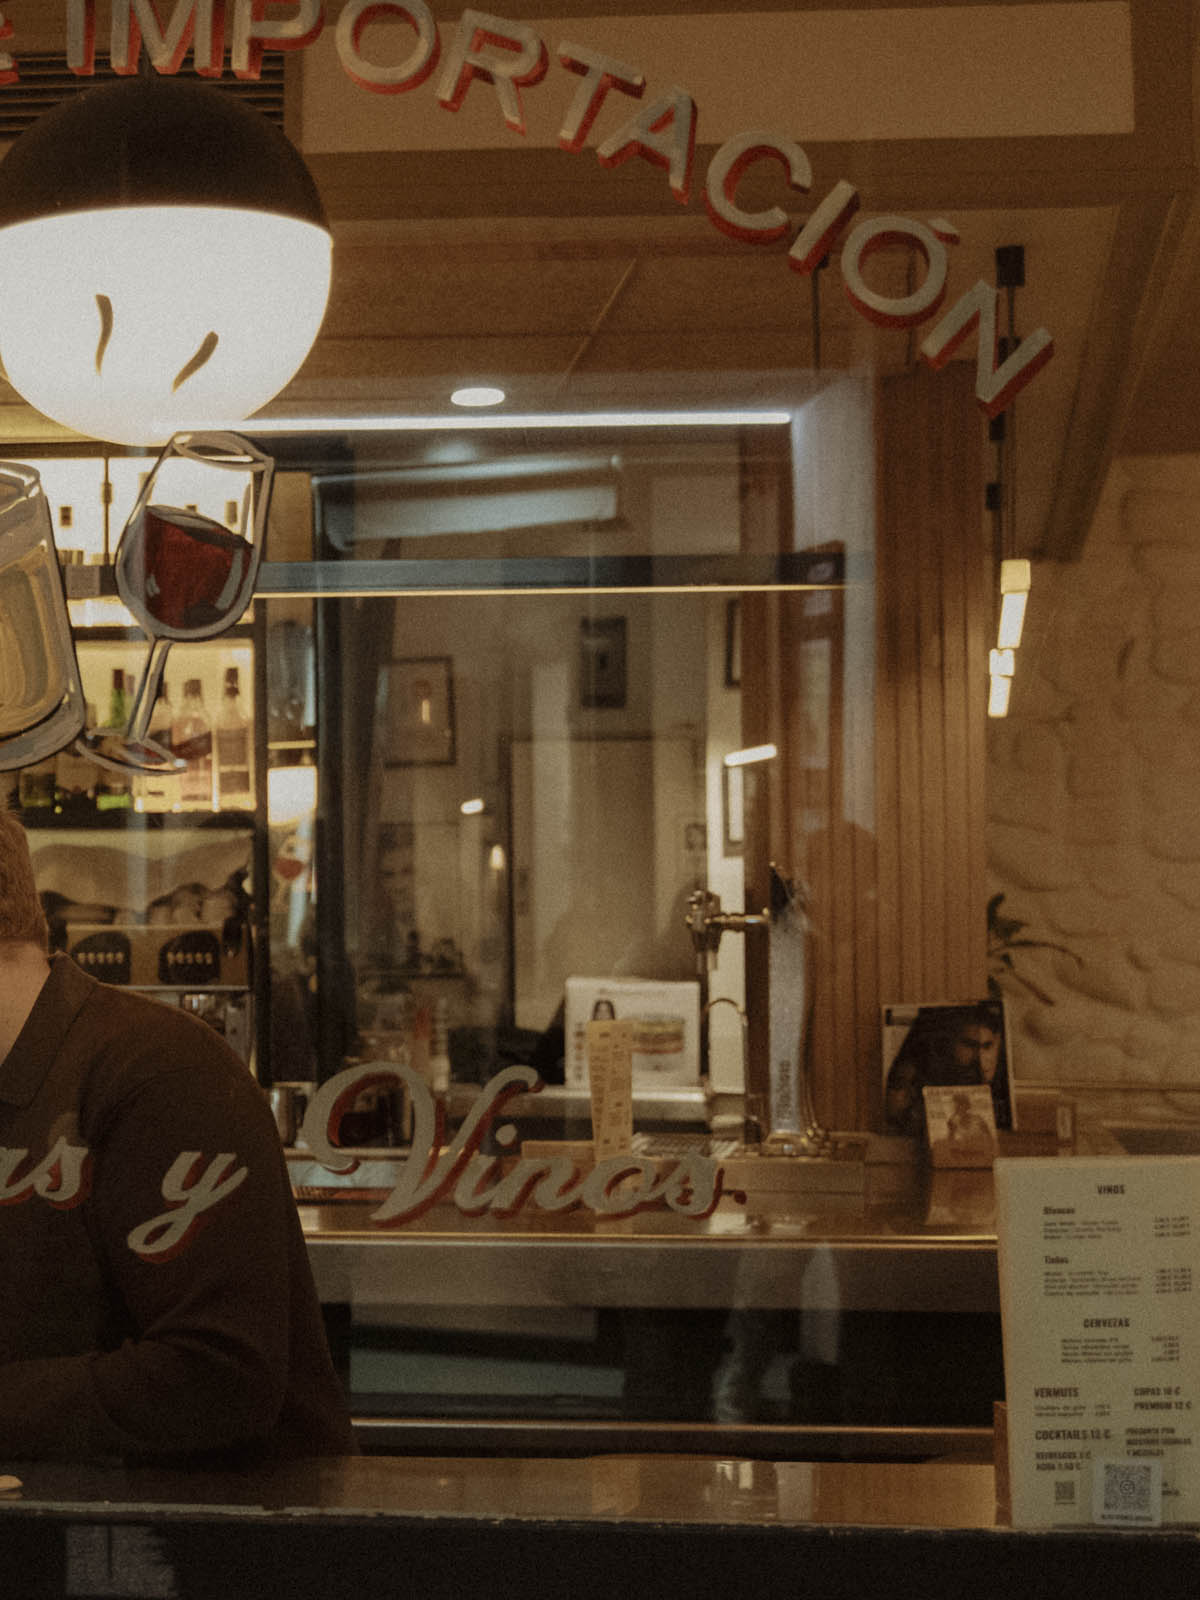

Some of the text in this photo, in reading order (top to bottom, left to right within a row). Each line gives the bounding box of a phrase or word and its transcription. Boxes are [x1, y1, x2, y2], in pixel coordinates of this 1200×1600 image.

[66, 0, 1054, 419] IMPORTACIÓN
[126, 1149, 248, 1263] y
[301, 1060, 747, 1229] Vinos
[1097, 1184, 1125, 1195] VINOS
[1083, 1318, 1130, 1328] CERVEZAS
[1034, 1387, 1079, 1398] VERMUTS
[1035, 1430, 1087, 1441] COCKTAILS
